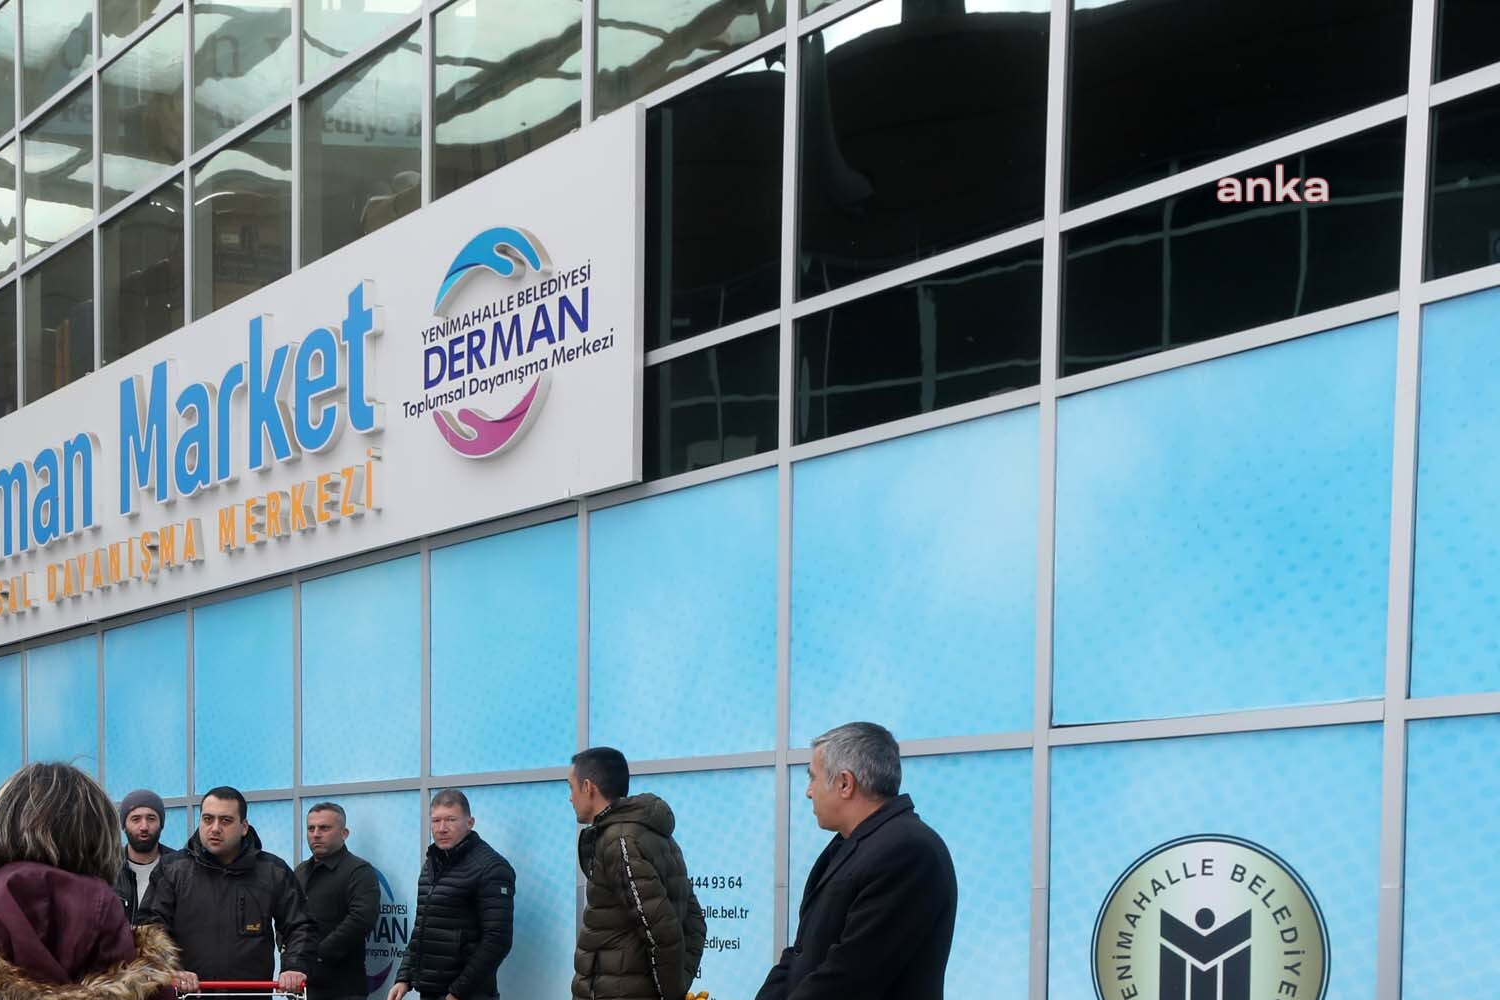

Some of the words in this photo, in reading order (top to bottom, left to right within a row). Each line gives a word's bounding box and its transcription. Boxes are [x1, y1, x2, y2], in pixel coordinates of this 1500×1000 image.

[422, 295, 514, 345] YENİMAHALLE
[517, 258, 591, 308] BELEDİYESİ
[423, 286, 589, 391] DERMAN
[119, 280, 377, 515] Market
[403, 381, 466, 419] Toplumsal
[469, 357, 548, 396] Dayanışma
[551, 327, 614, 368] Merkezi
[46, 519, 197, 603] DAYANIŞMA
[218, 448, 374, 552] MERKEZİ
[701, 906, 749, 919] alle.bel.tr
[711, 876, 725, 889] 93
[728, 876, 743, 889] 64
[703, 937, 741, 952] ediyesi
